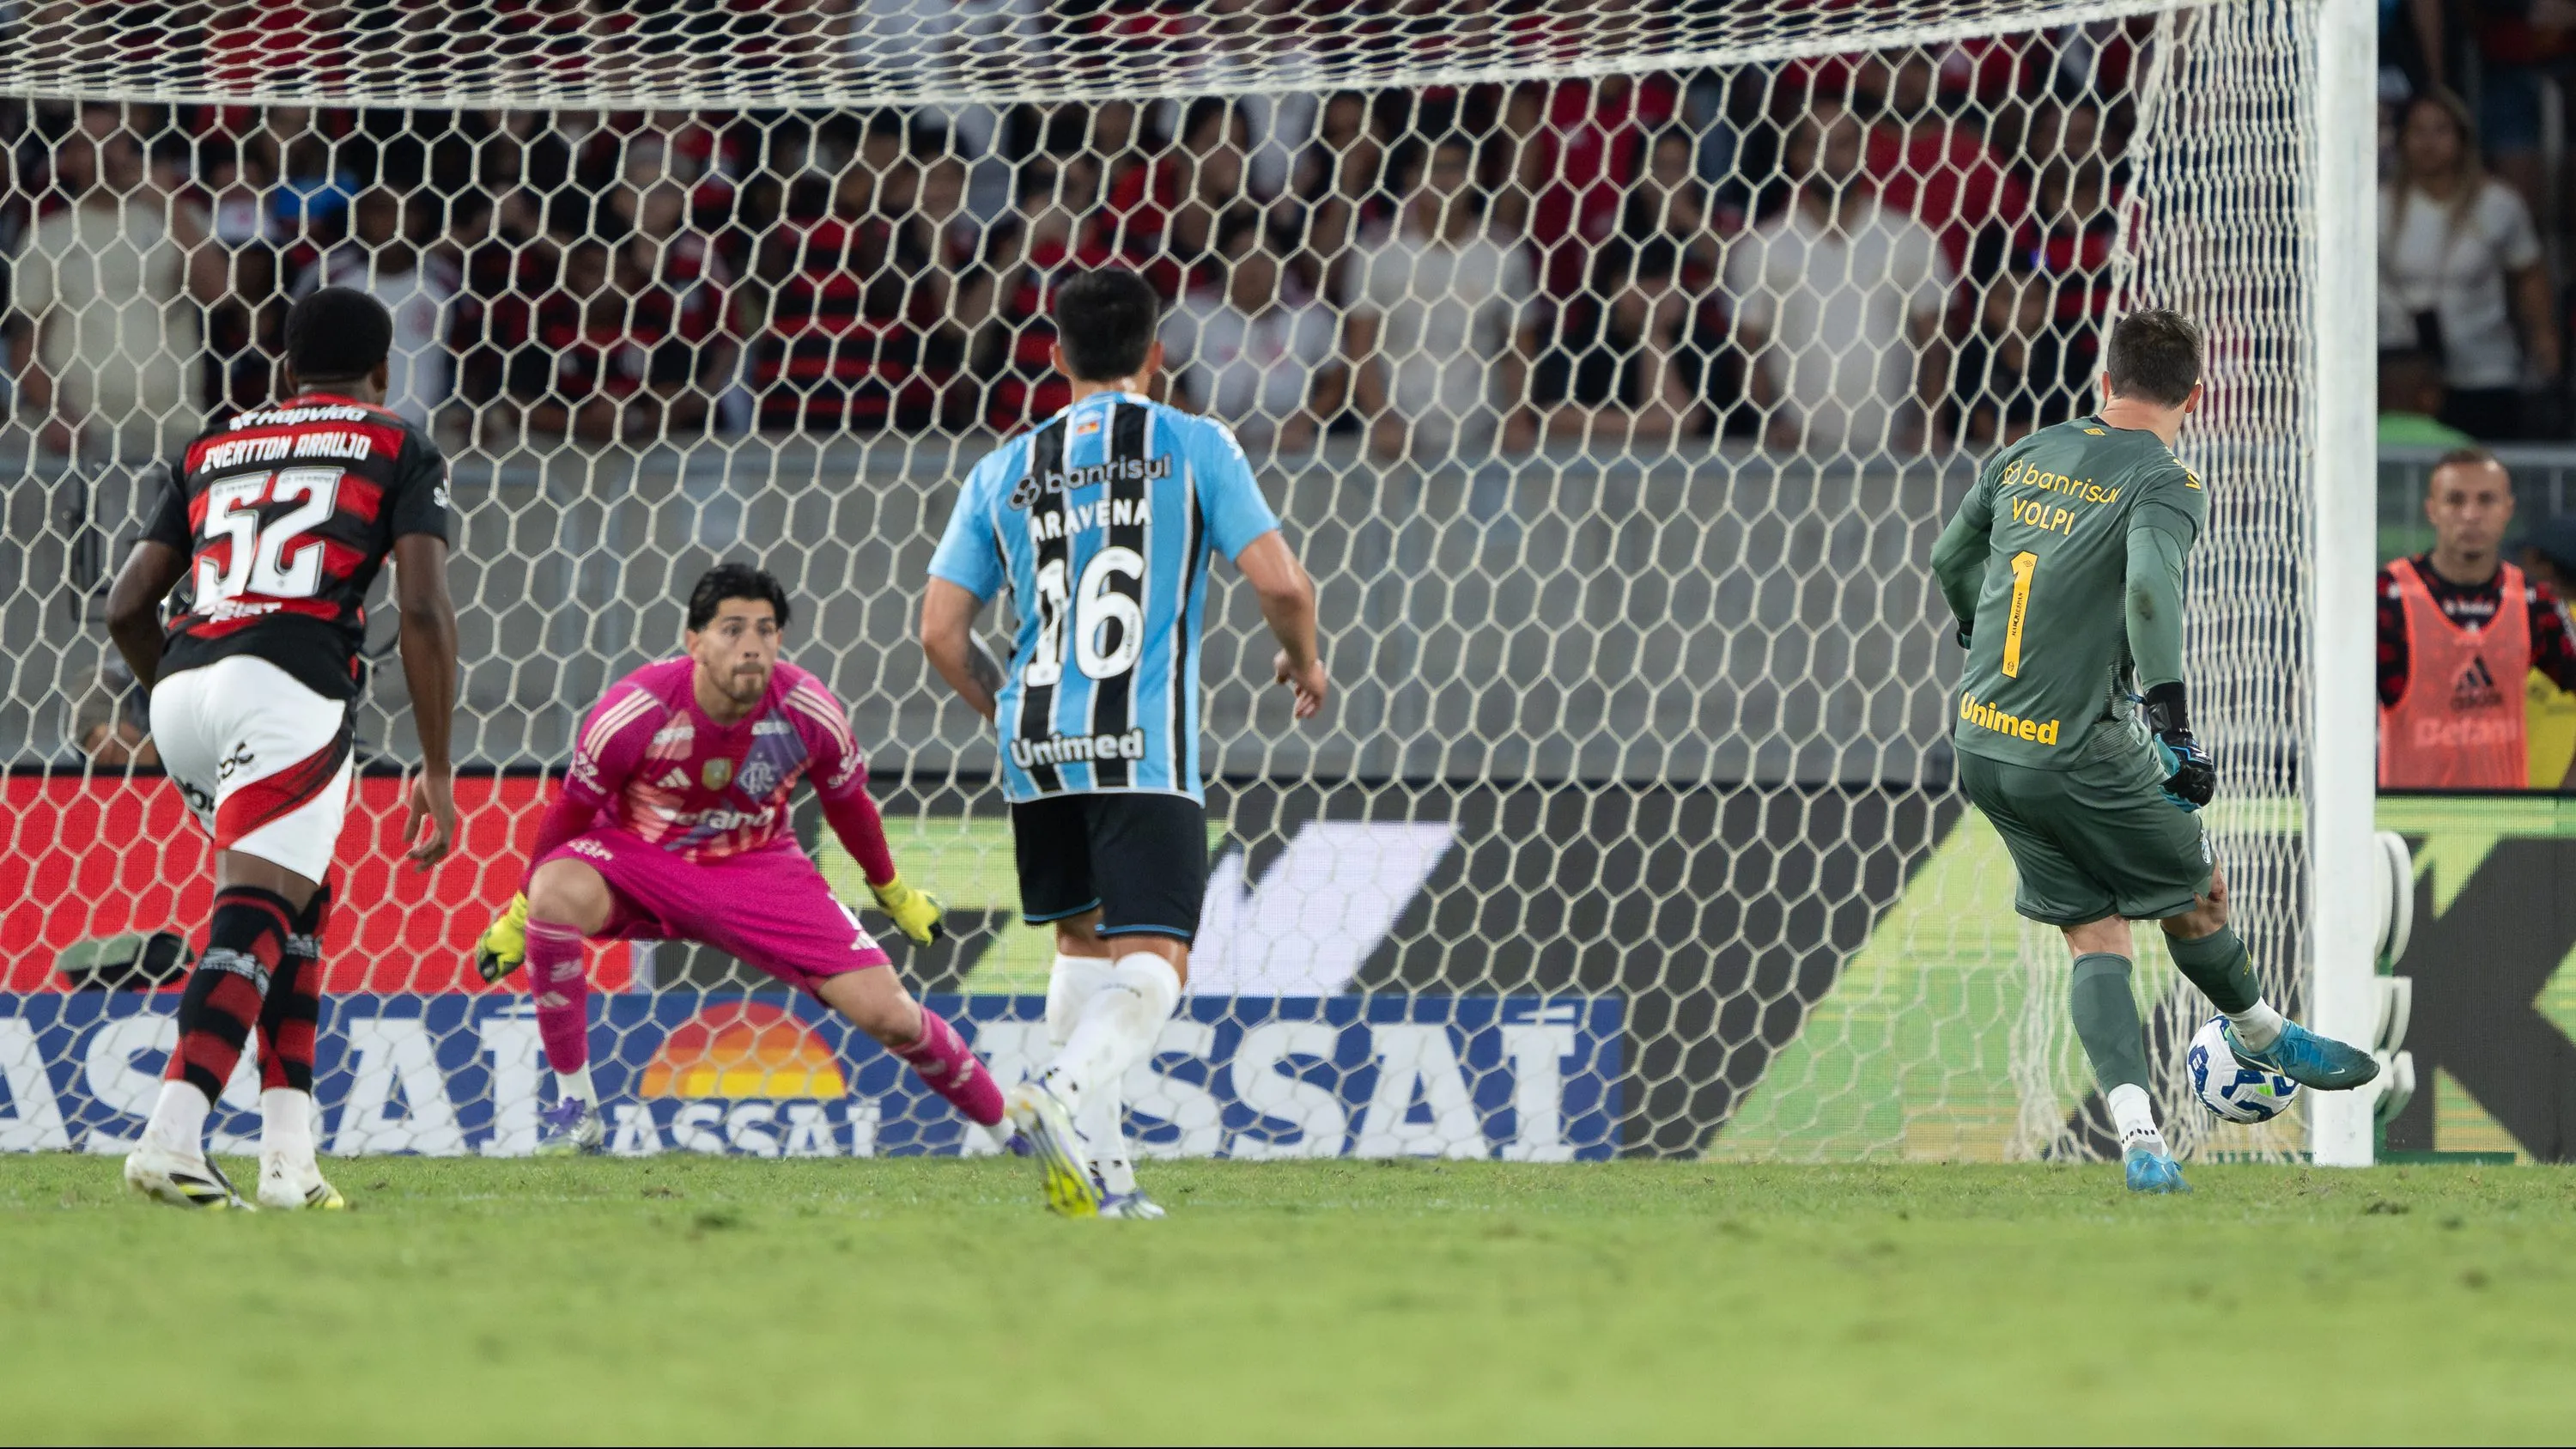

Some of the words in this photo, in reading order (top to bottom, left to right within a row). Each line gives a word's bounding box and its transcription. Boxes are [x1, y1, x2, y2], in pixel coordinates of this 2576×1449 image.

[201, 435, 292, 474] EVERTTON
[1044, 454, 1172, 495] banrisul
[2022, 462, 2122, 503] banrisul
[1031, 497, 1152, 543] ARAVENA
[2012, 495, 2075, 536] VOLPI
[194, 466, 345, 611] 52
[1024, 545, 1145, 687] 16
[2002, 551, 2038, 679] 1
[1959, 691, 2060, 746] Unimed
[1010, 728, 1145, 770] Unimed
